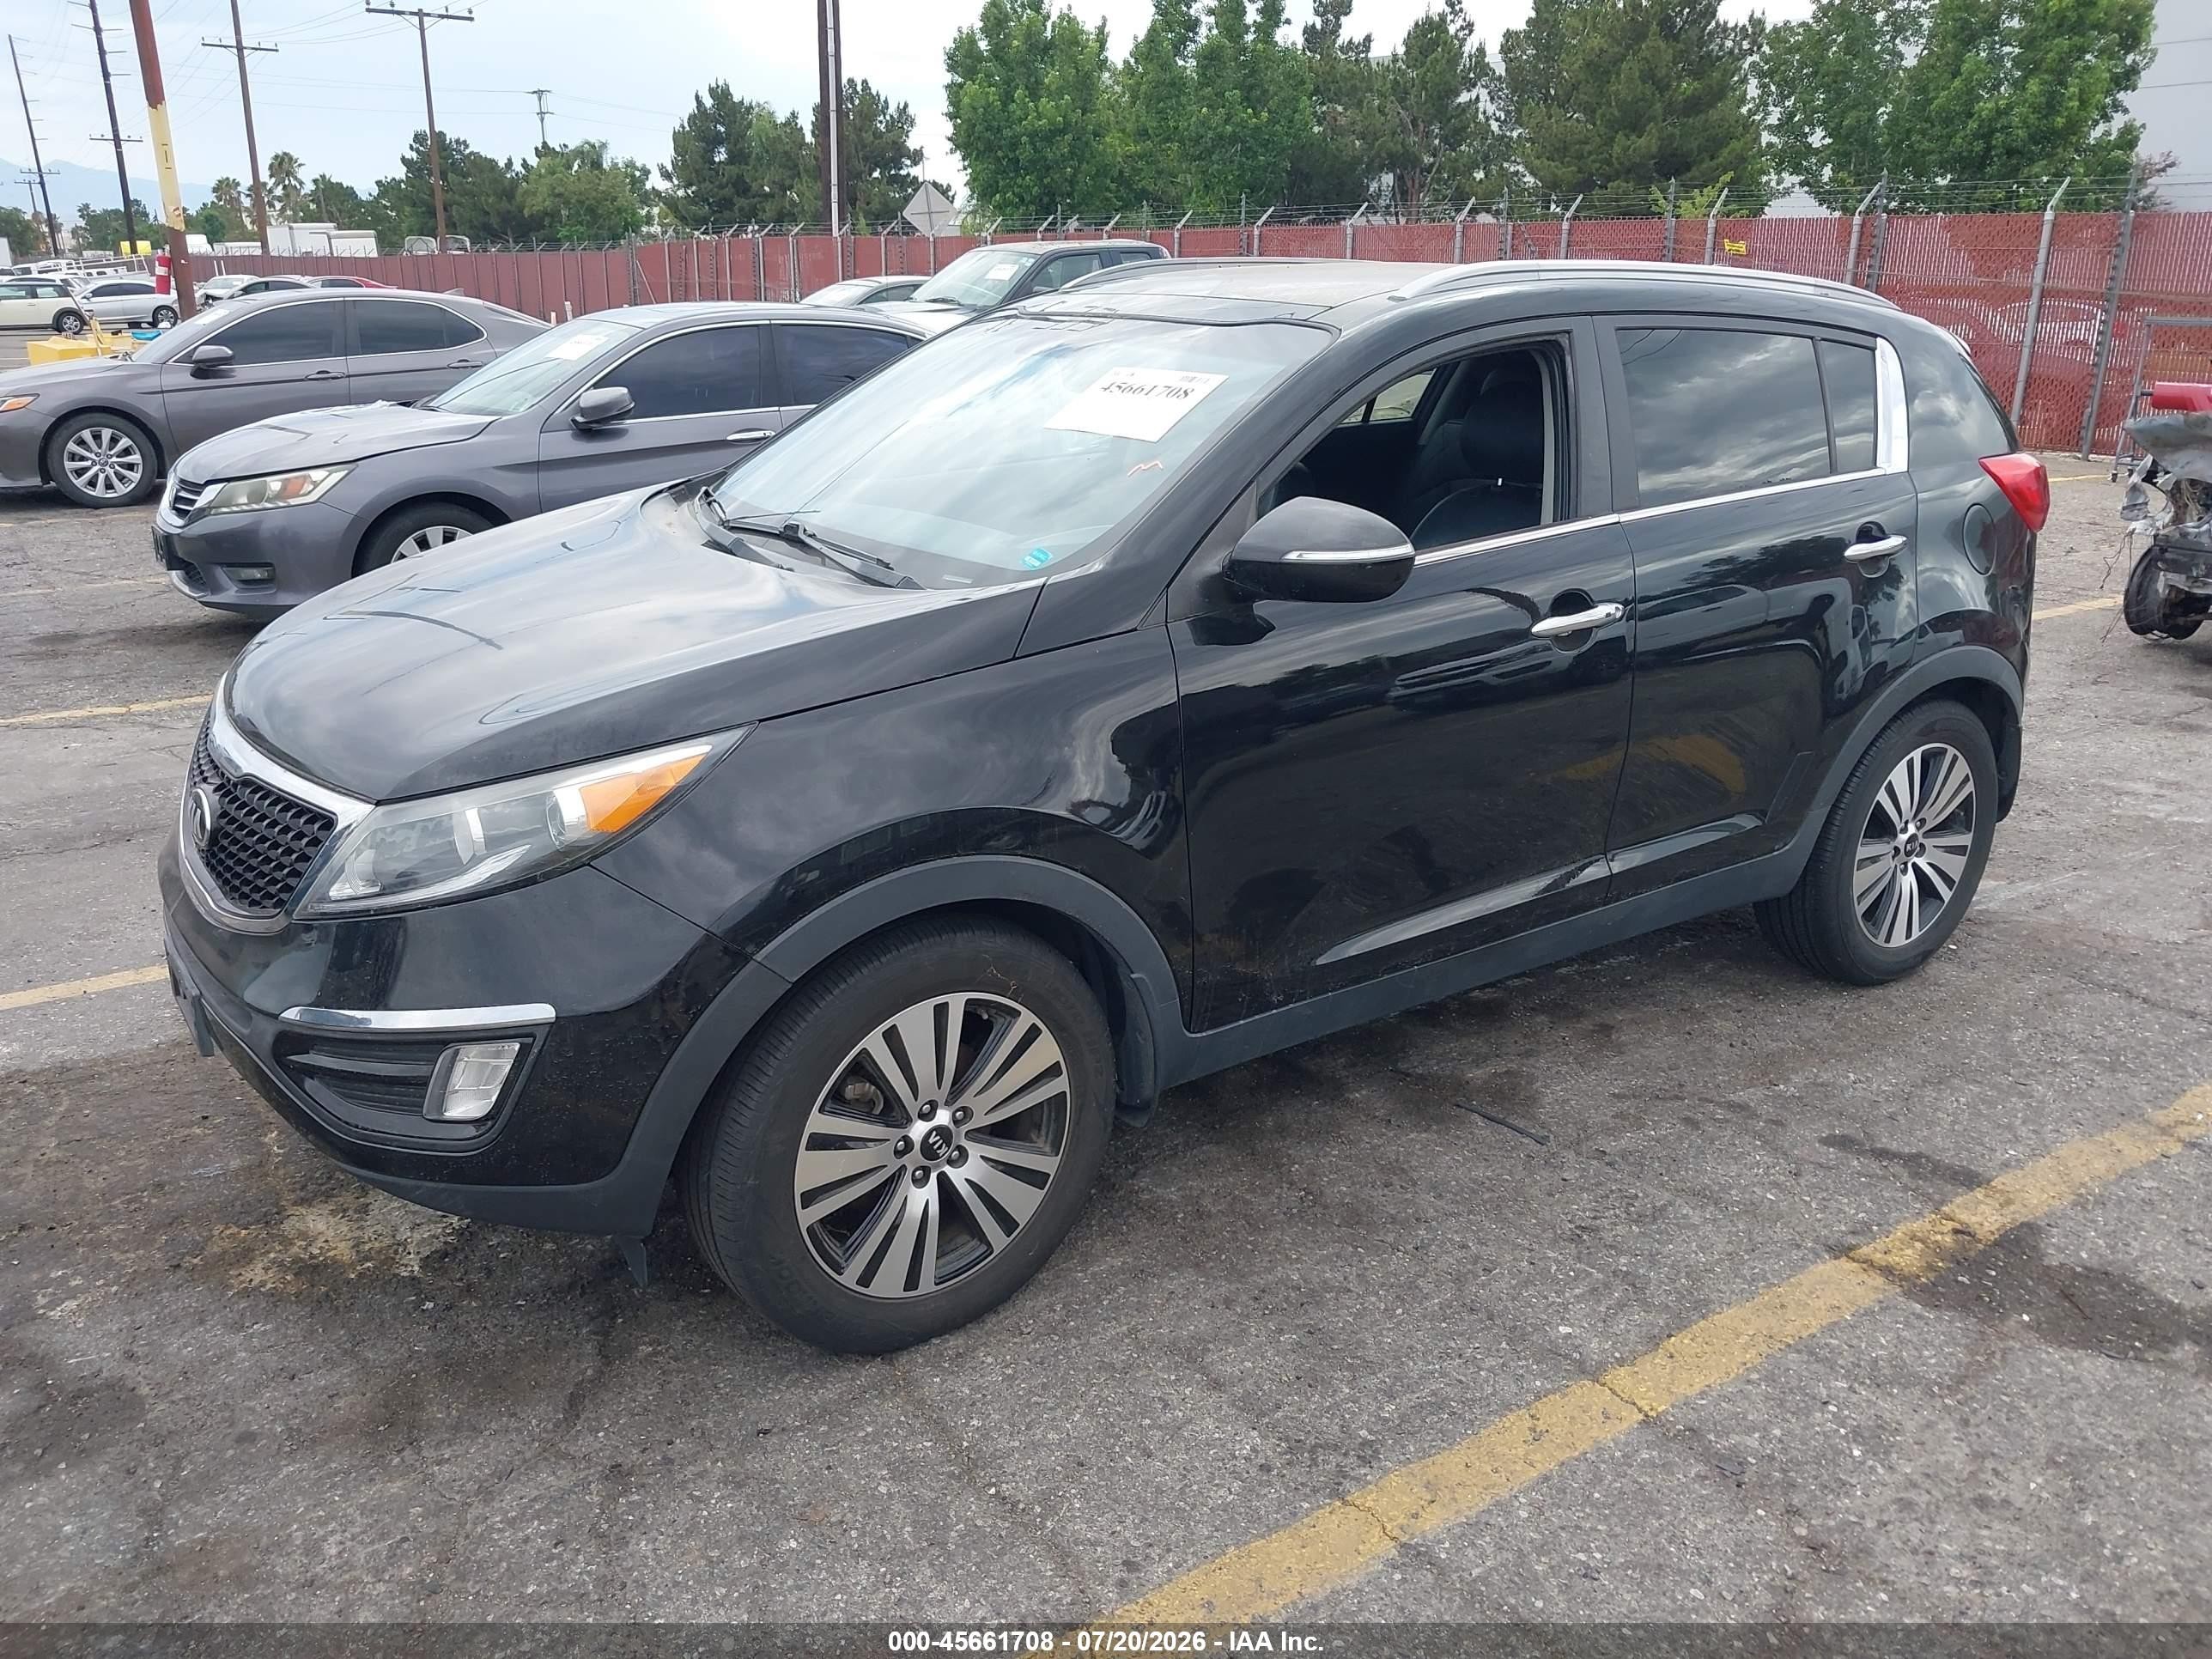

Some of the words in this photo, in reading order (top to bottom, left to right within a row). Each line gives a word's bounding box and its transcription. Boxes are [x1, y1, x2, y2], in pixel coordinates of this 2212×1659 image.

[1100, 380, 1195, 400] 45661708
[1905, 840, 1919, 853] KIA
[927, 1130, 950, 1158] KIA
